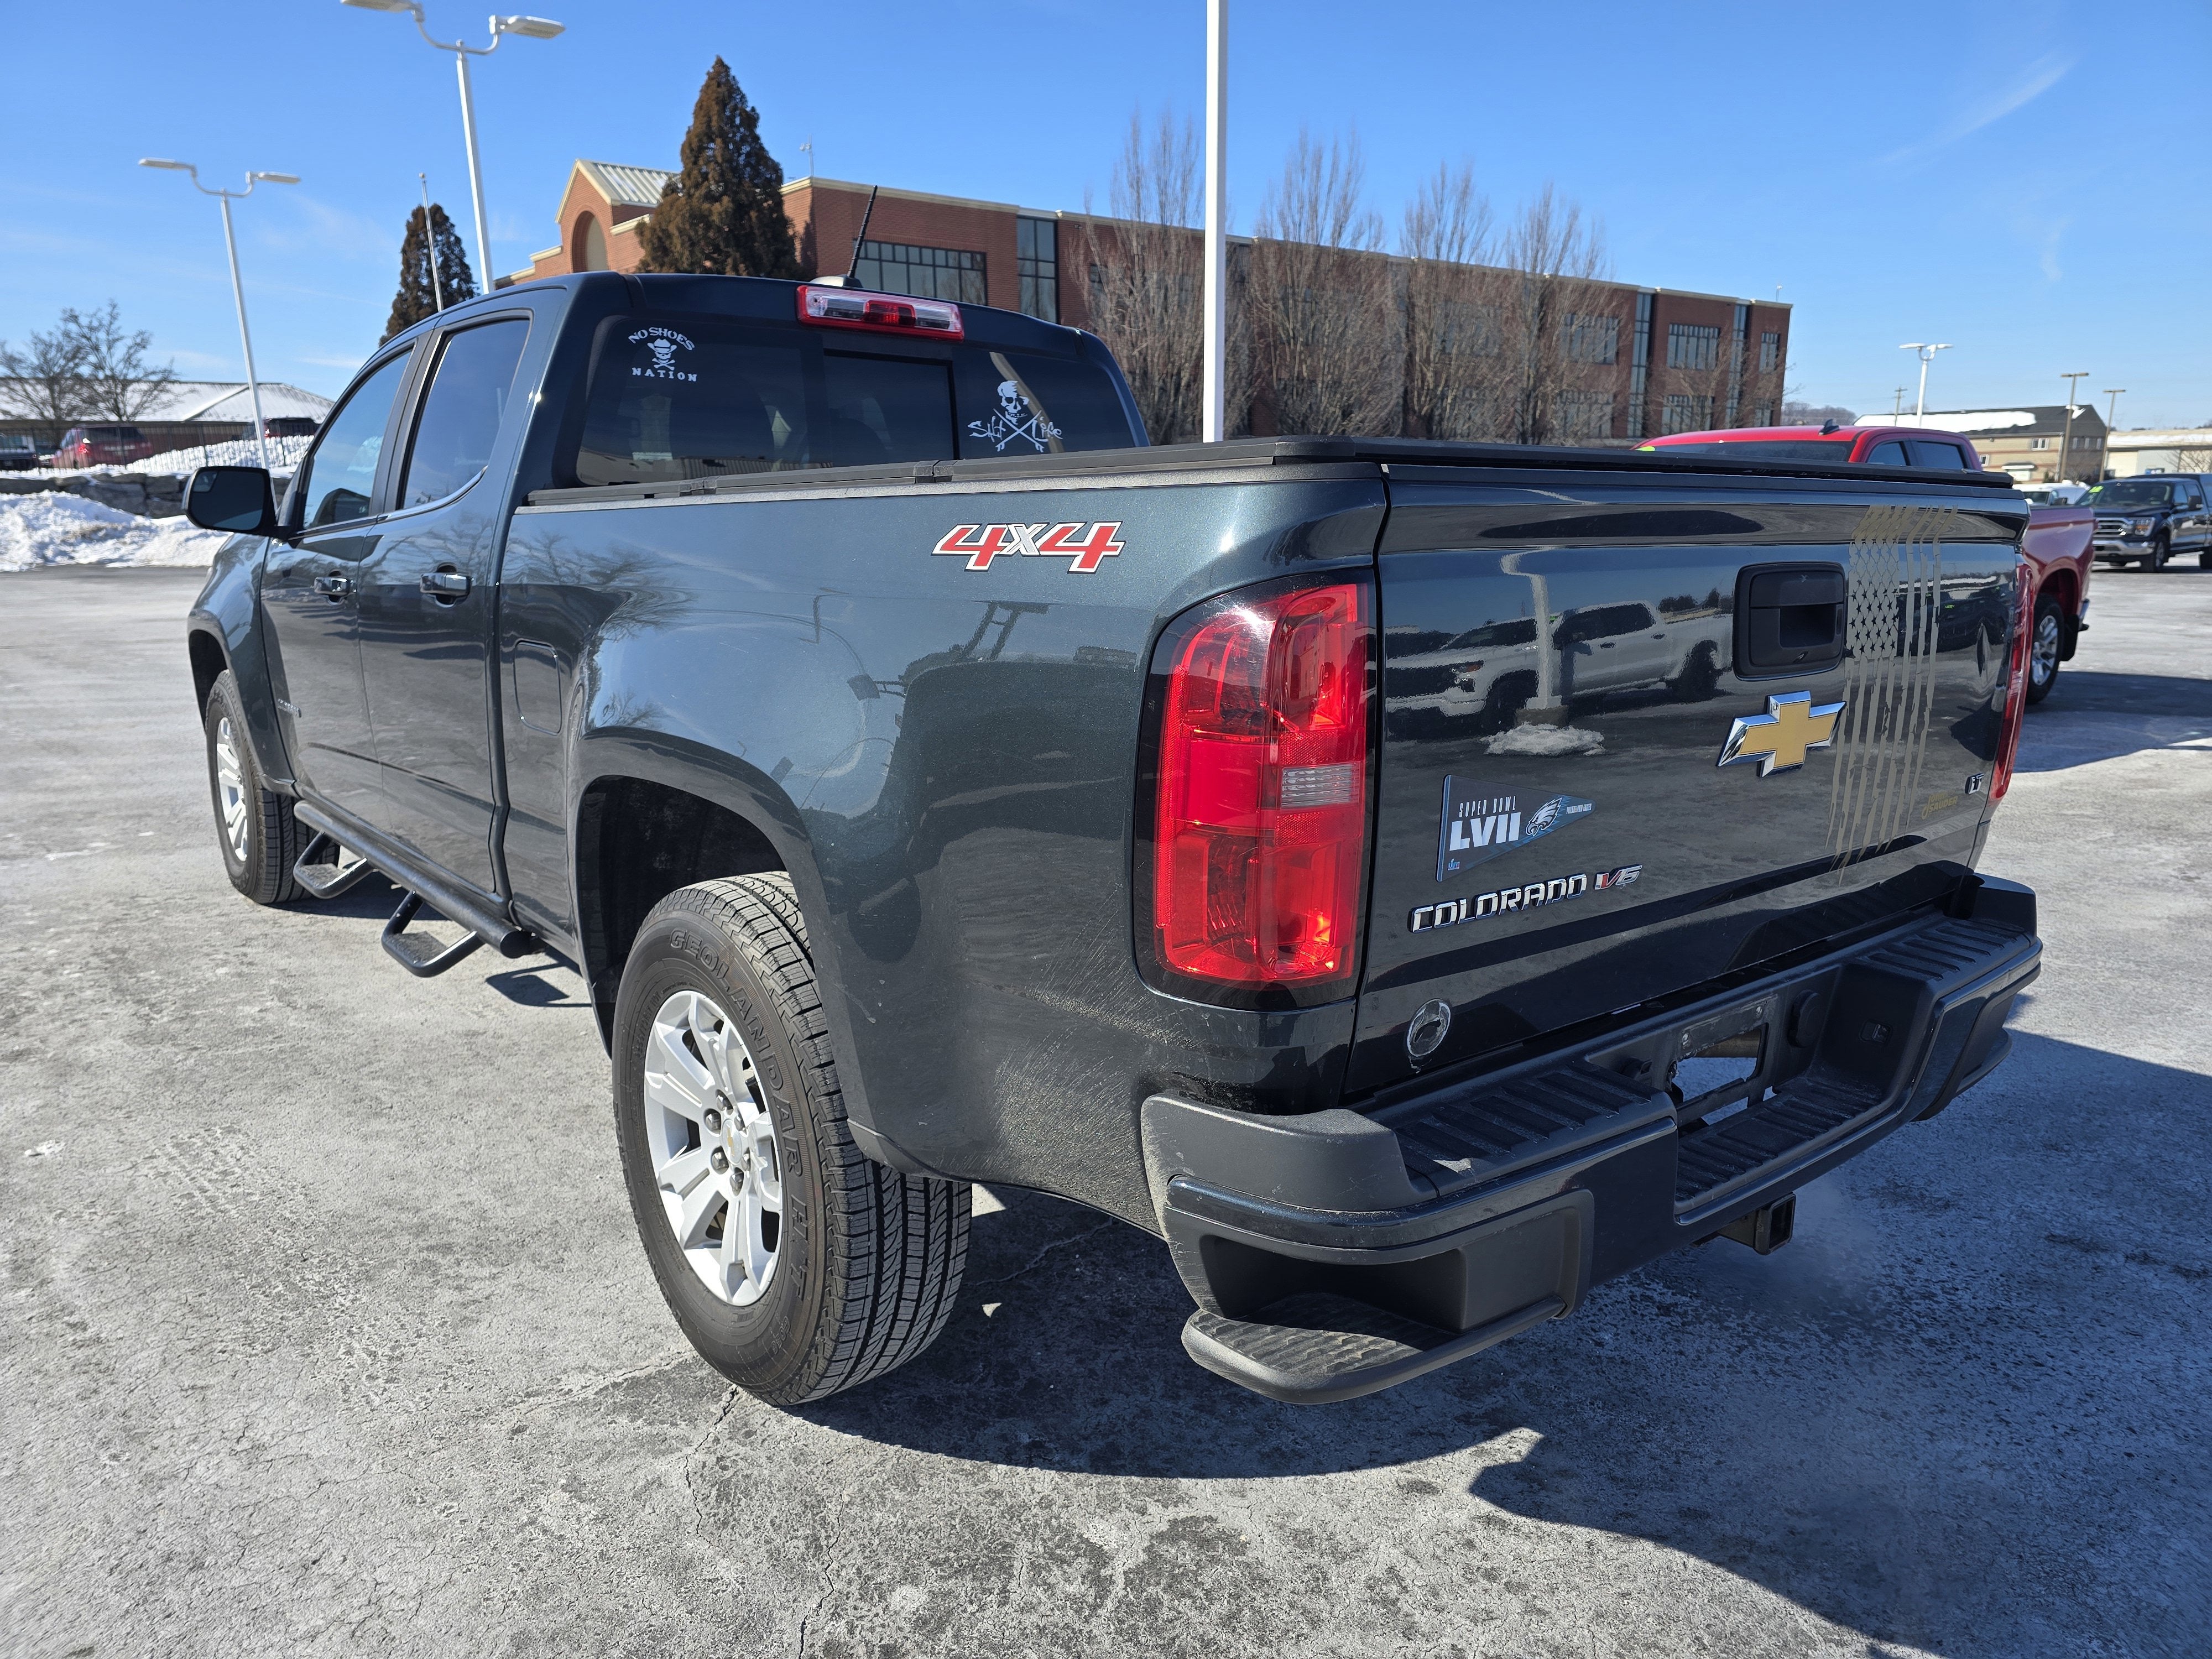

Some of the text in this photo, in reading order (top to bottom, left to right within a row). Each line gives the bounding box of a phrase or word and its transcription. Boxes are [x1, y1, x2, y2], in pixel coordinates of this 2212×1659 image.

[628, 327, 695, 351] NO SHOES
[632, 367, 697, 382] NATION
[1968, 773, 1985, 795] LT
[1459, 795, 1517, 818] SUPER BOWL
[1928, 796, 1958, 813] SAUDER
[1449, 812, 1521, 851] LVII
[1409, 864, 1644, 933] COLORADO V6
[669, 927, 802, 1178] GEOLANDAR
